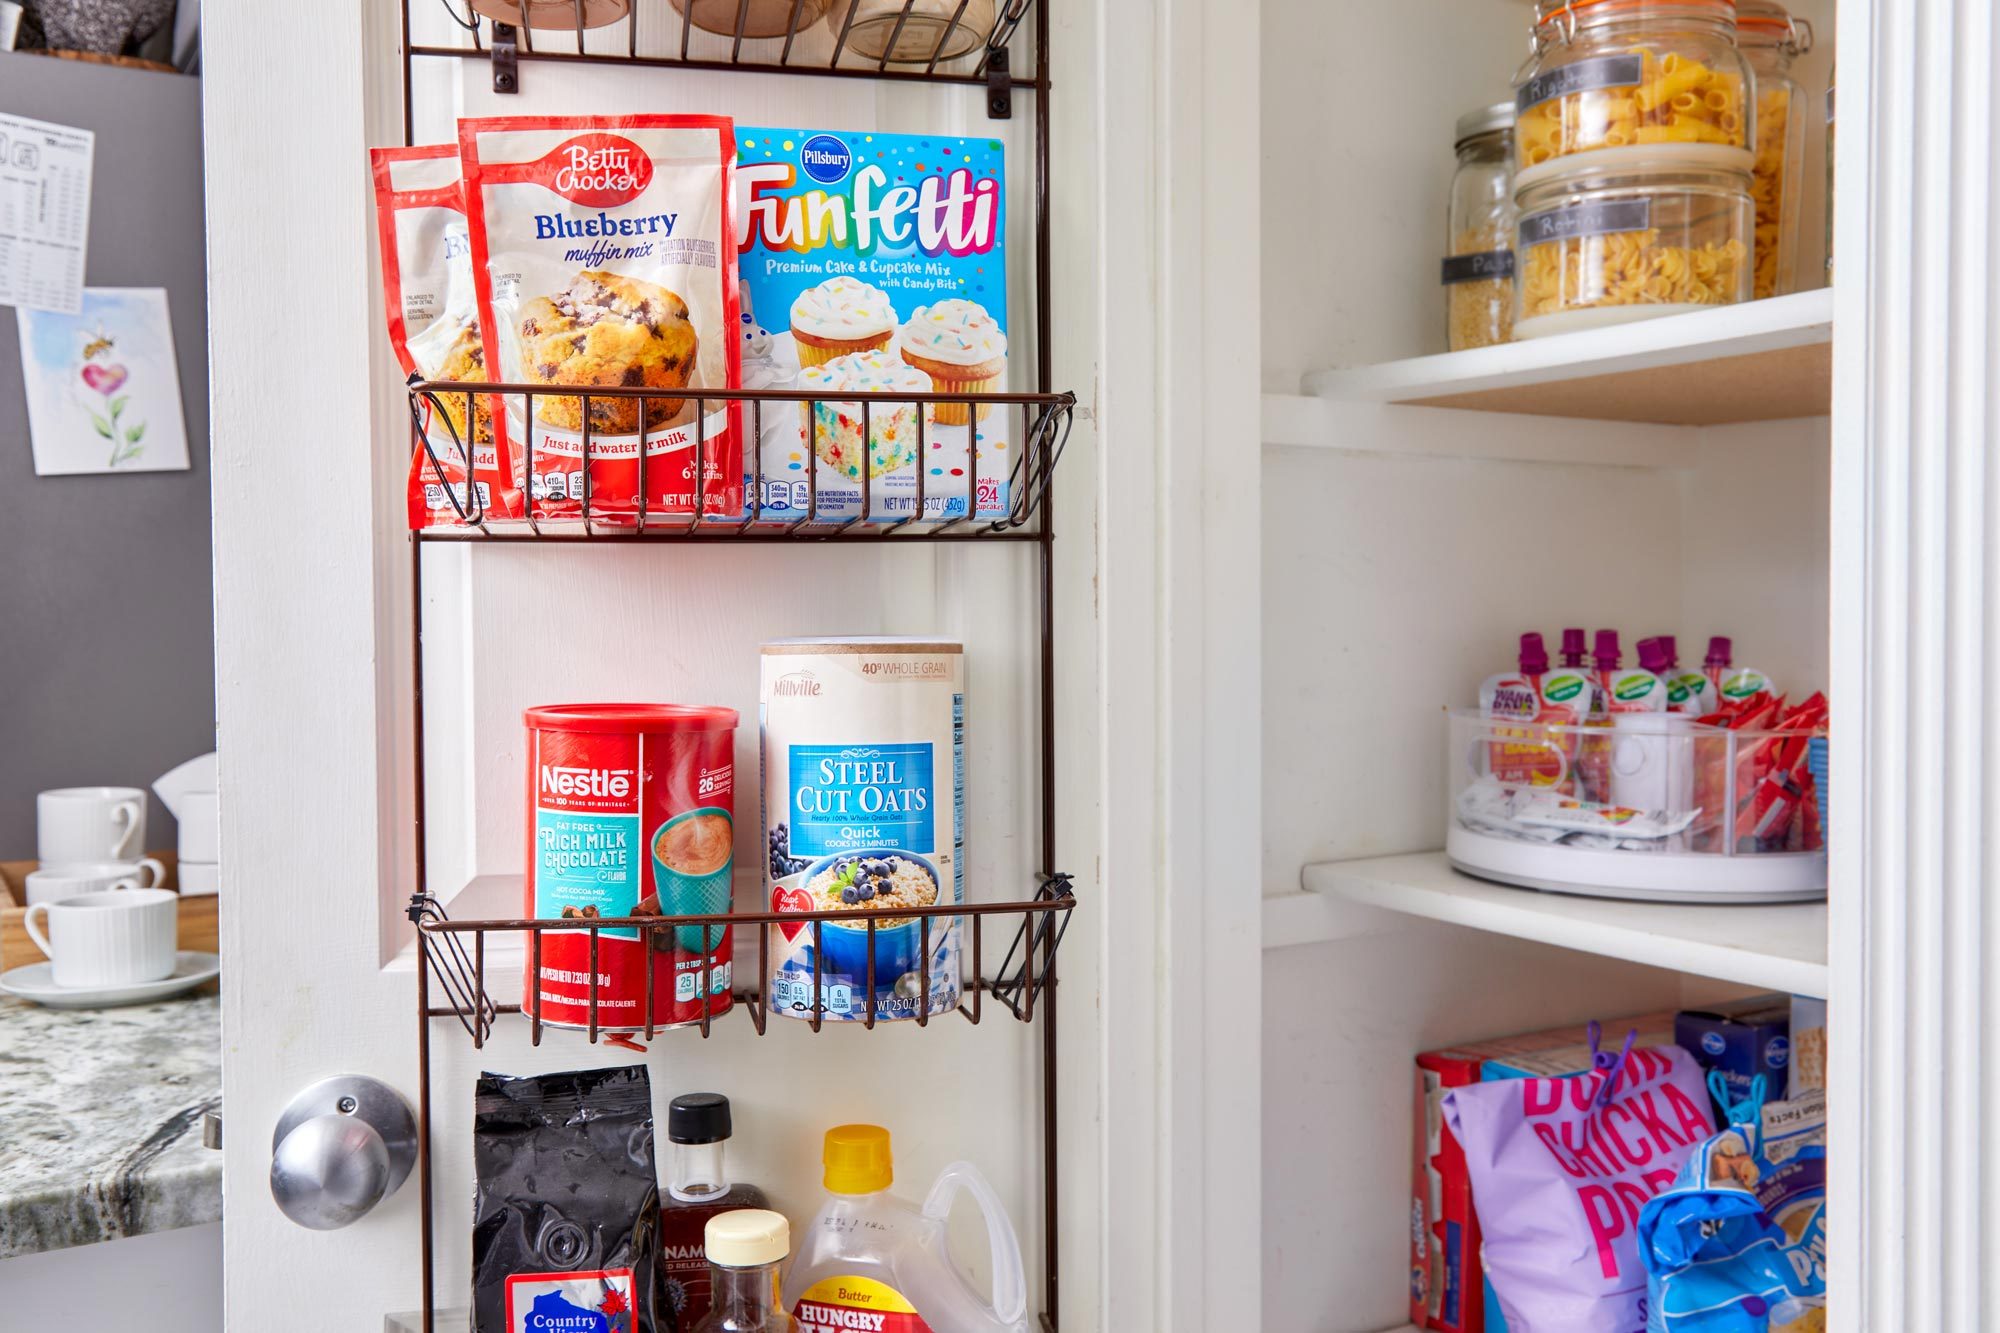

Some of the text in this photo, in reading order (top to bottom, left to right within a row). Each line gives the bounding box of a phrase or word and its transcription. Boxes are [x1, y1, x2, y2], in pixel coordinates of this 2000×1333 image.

[562, 145, 631, 176] Betty
[804, 149, 849, 168] Pillsbury
[556, 167, 646, 192] Crocker
[735, 162, 996, 253] Funfetti
[535, 212, 678, 239] Blueberry
[564, 240, 653, 268] muffin mix
[766, 259, 951, 277] Premium Cake & Cupcake Mix
[1472, 254, 1513, 273] Past
[879, 277, 957, 290] with Candy Bits
[543, 436, 569, 450] Just
[599, 443, 637, 454] water
[656, 432, 688, 449] milk
[690, 460, 718, 470] Mkes
[682, 467, 691, 479] 6
[977, 478, 999, 486] Makes
[663, 494, 677, 505] NET
[679, 494, 691, 505] WT
[977, 486, 998, 503] 24
[884, 498, 897, 510] NET
[900, 498, 910, 510] WT
[931, 498, 940, 510] OZ
[942, 497, 965, 512] (432g)
[883, 662, 919, 674] WHOLE
[922, 662, 946, 674] GRAIN
[774, 679, 821, 696] Millville
[714, 769, 731, 781] DELICIOU
[819, 759, 902, 785] STEEL
[542, 765, 629, 797] Nestlé
[699, 776, 714, 794] 26
[556, 797, 567, 805] 100
[797, 786, 927, 812] CUT OATS
[811, 815, 830, 823] Hearty
[557, 822, 594, 832] FAT FREE
[841, 825, 881, 840] Quick
[540, 827, 626, 851] RICH MILK
[825, 840, 850, 848] COOKS
[867, 839, 899, 847] MINUTES
[544, 851, 627, 873] CHOCOLATE
[676, 962, 685, 970] PER
[559, 969, 571, 983] NETO
[572, 971, 582, 984] 7.33
[681, 976, 691, 987] 25
[778, 984, 788, 994] 150
[597, 999, 614, 1007] COLATE
[877, 1000, 890, 1011] WT
[892, 1000, 902, 1011] 25
[903, 998, 913, 1009] OZ
[1533, 1082, 1714, 1178] CHICKA
[665, 1244, 704, 1259] NAM
[676, 1261, 710, 1269] RELEASE
[838, 1288, 872, 1303] Butter
[533, 1315, 597, 1329] Country
[801, 1304, 885, 1331] HUNGRY
